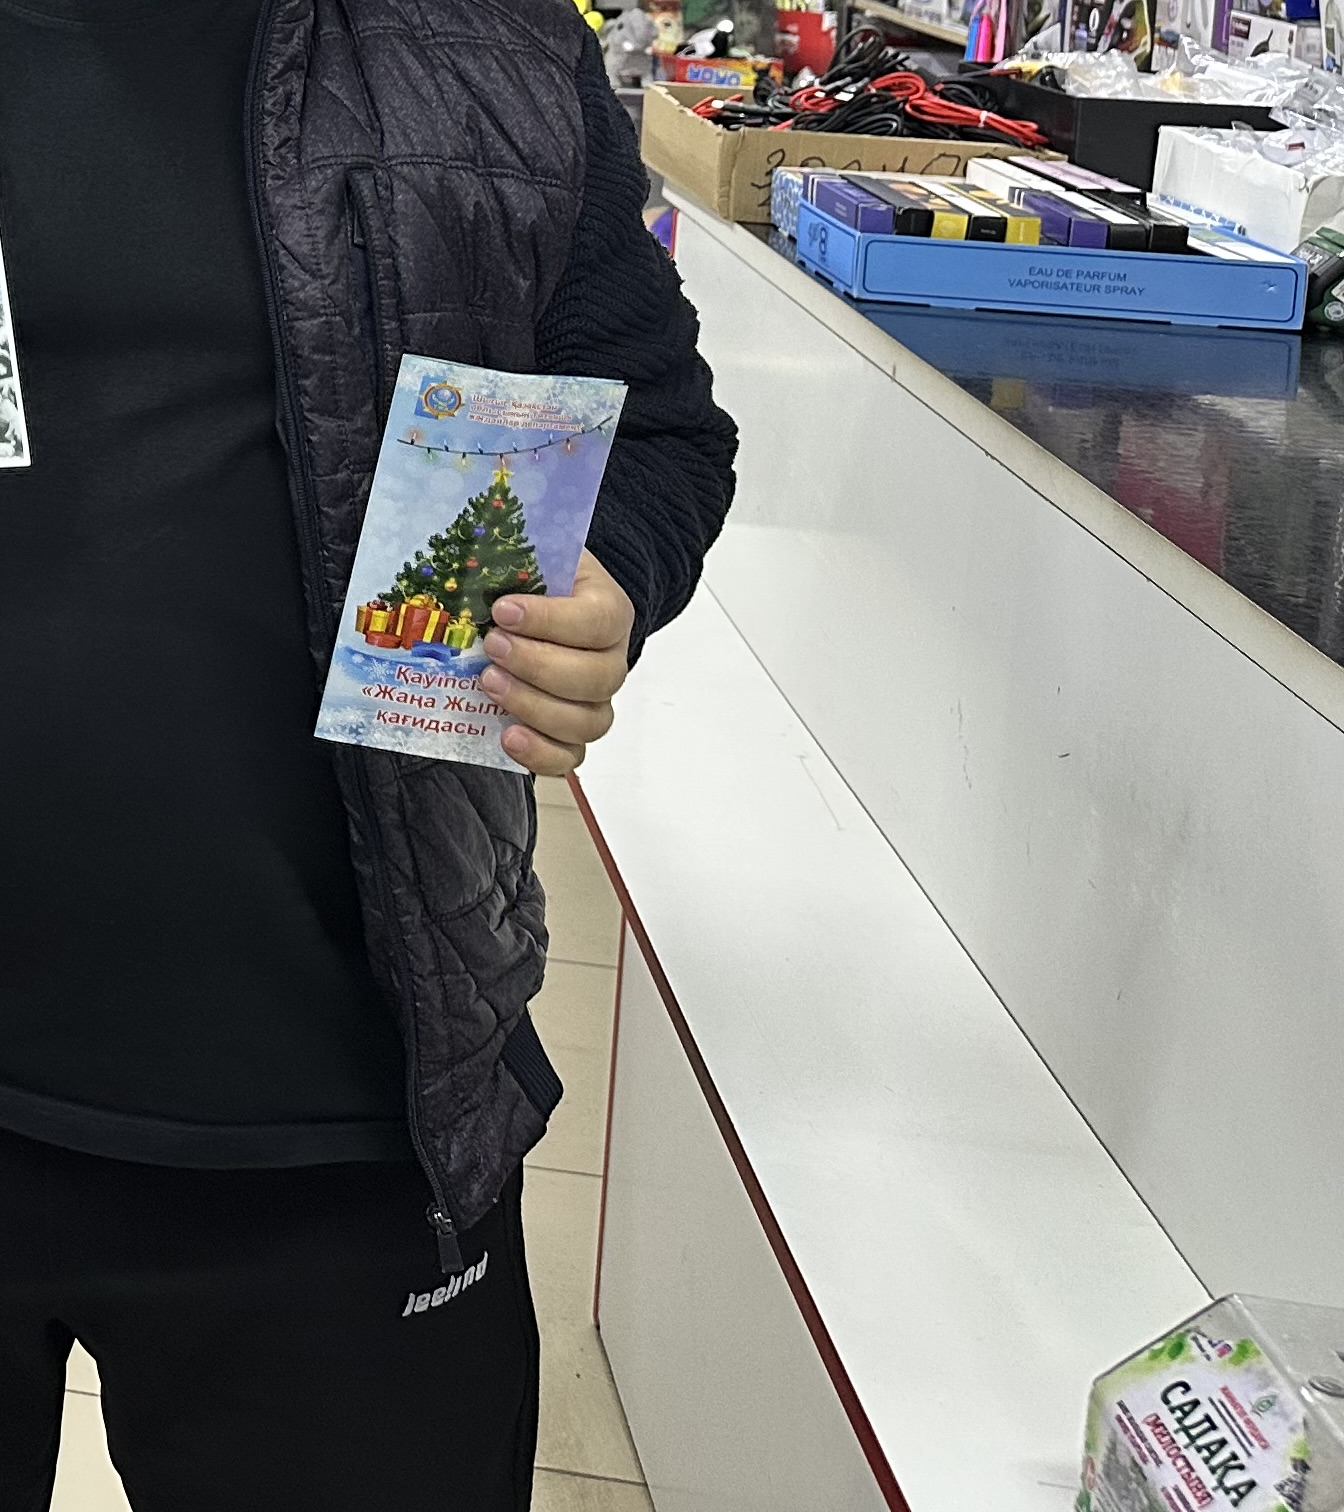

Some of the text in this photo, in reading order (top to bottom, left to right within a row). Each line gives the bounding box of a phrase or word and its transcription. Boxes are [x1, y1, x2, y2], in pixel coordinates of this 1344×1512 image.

[1029, 266, 1127, 282] EAU DE PARFUM
[1008, 278, 1145, 297] VAPORISATEUR SPRAY
[362, 684, 511, 716] «Жаңа Жыл»
[376, 710, 486, 736] қағидасы
[1160, 1379, 1257, 1508] САДАҚА
